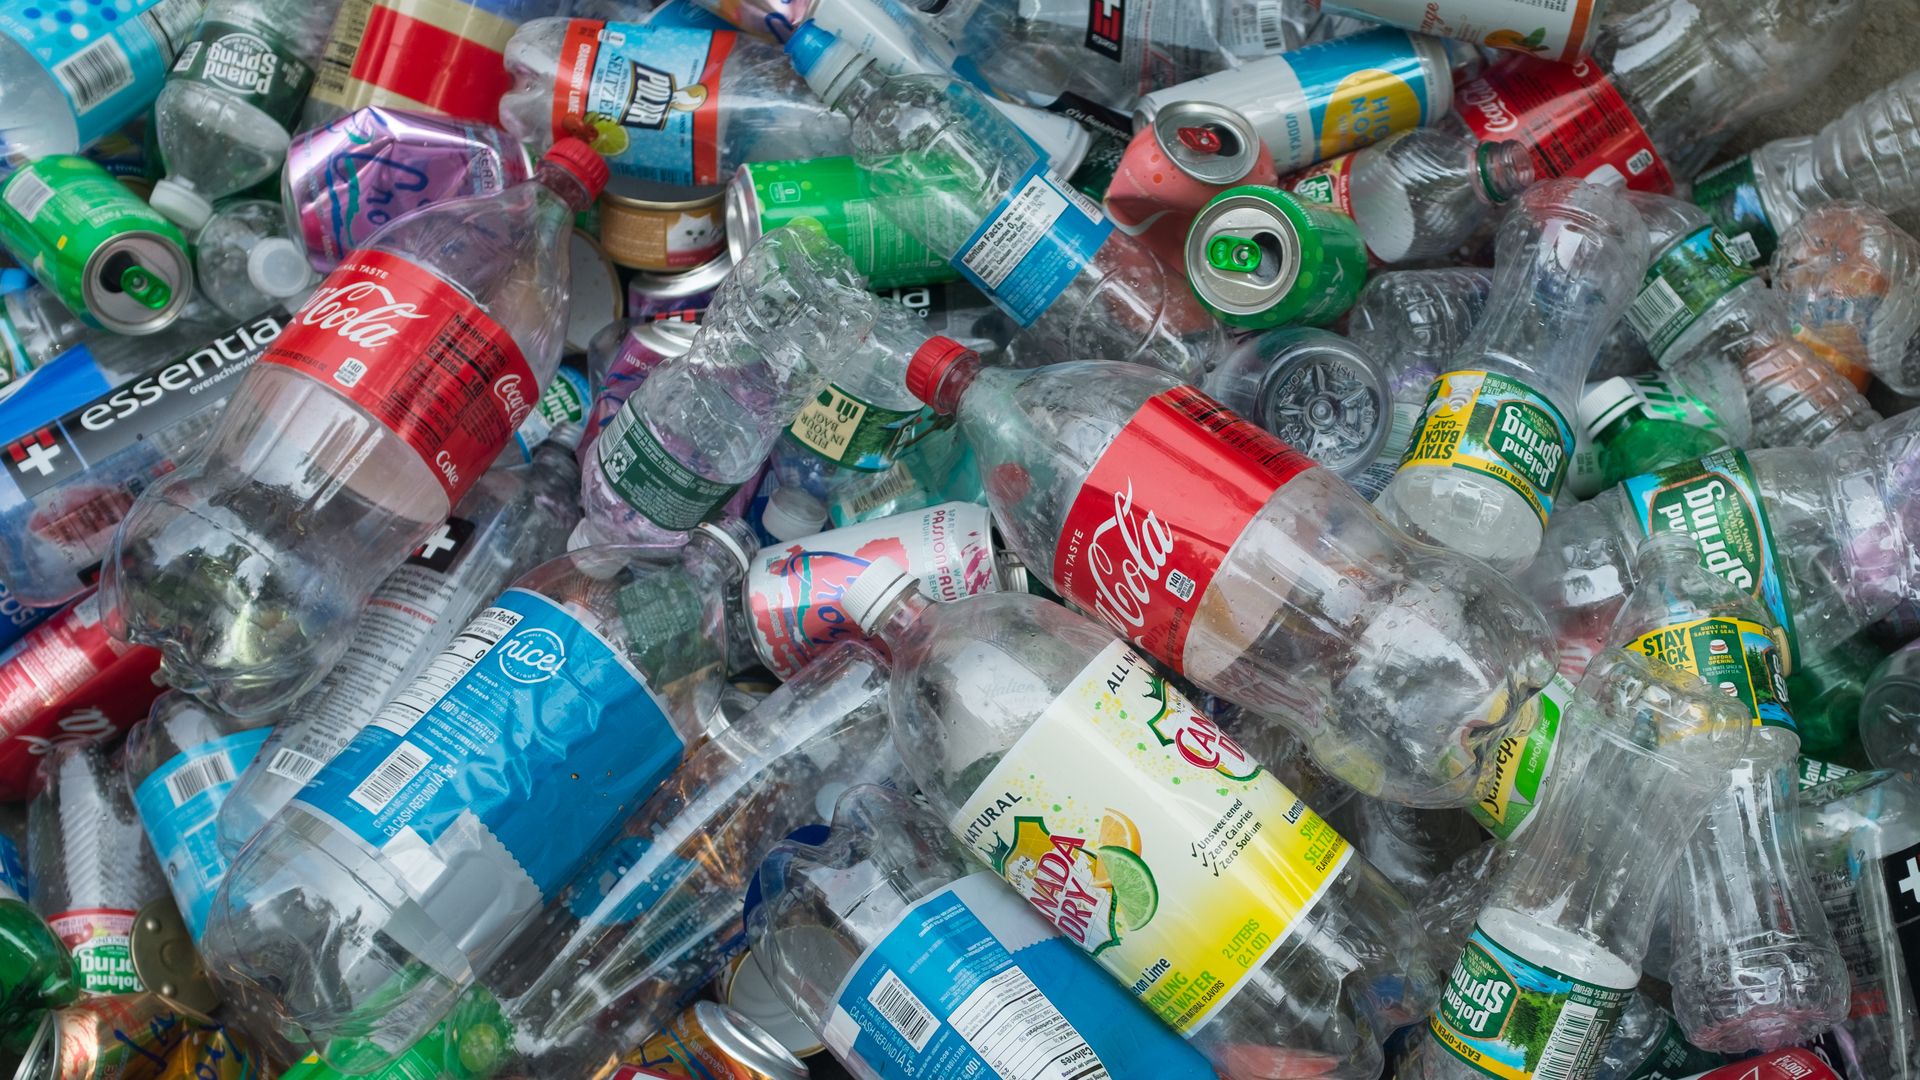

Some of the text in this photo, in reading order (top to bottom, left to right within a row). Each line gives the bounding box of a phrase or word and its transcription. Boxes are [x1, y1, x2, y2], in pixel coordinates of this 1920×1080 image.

[202, 60, 273, 94] Poland
[209, 42, 278, 74] Spring
[567, 44, 591, 115] CRANBERRY LIME
[599, 53, 624, 122] SELTZER
[624, 66, 670, 126] POLAR
[1286, 113, 1302, 148] VODKA
[1371, 96, 1390, 140] HIG
[963, 238, 988, 264] Nutrition
[984, 221, 1004, 242] Facts
[359, 265, 390, 280] TASTE
[453, 312, 489, 349] Nutrition
[81, 316, 282, 431] essentia
[347, 359, 362, 374] 140
[429, 343, 484, 399] Calories 140
[801, 413, 845, 447] IN YOUR
[805, 430, 829, 450] FITS
[813, 411, 839, 431] BAG!
[1422, 429, 1460, 444] BACK
[1501, 406, 1562, 473] Spring
[436, 450, 459, 486] Coke
[1411, 443, 1456, 460] STAY
[1500, 437, 1551, 488] Poland
[1485, 462, 1543, 513] EASY-OPEN TOP!
[1683, 480, 1753, 590] Spring
[1725, 507, 1746, 553] NATURAL
[1729, 492, 1756, 563] SPRING WATER
[1066, 529, 1085, 568] TASTE
[1168, 572, 1182, 588] 140
[494, 610, 518, 626] Facts
[1693, 628, 1736, 638] SAFETY SEAL
[1700, 624, 1728, 632] BUILT-IN
[497, 639, 567, 676] nice!
[1643, 626, 1687, 657] STAY
[1708, 653, 1734, 661] BEFORE
[475, 671, 499, 688] Refresh
[1106, 664, 1130, 695] ALL
[1708, 658, 1735, 666] OPENING
[466, 683, 490, 701] Refresh
[439, 699, 499, 741] 100% SATISFACTION
[456, 714, 495, 744] GUARANTEED
[1174, 715, 1221, 770] CAN
[1527, 718, 1550, 774] LEMON LIME
[383, 825, 398, 837] CA
[392, 808, 417, 829] CASH
[409, 781, 440, 812] REFUND
[963, 792, 1023, 846] NATURAL
[1197, 798, 1244, 850] Unsweetened
[1208, 809, 1254, 860] Zero Calories
[1219, 821, 1263, 870] Zero Sodium
[1030, 835, 1086, 923] NADA
[1315, 849, 1336, 873] FLAVORED
[1057, 877, 1098, 944] DRY
[1222, 917, 1262, 959] 2 LITERS
[1236, 931, 1273, 970] (2.1 QT)
[1141, 958, 1171, 983] Lime
[1174, 970, 1218, 1010] WATER
[1450, 948, 1511, 1014] Sprin
[1572, 983, 1594, 997] REFUND
[1187, 1001, 1205, 1019] NATURAL
[1202, 979, 1225, 1004] FLAVORS
[1443, 983, 1491, 1032] Poland
[849, 1006, 860, 1020] CA
[858, 1015, 875, 1036] CASH
[873, 1030, 896, 1060] REFUND
[1440, 1026, 1481, 1063] EASY-OPEN
[1060, 1046, 1094, 1066] Calories
